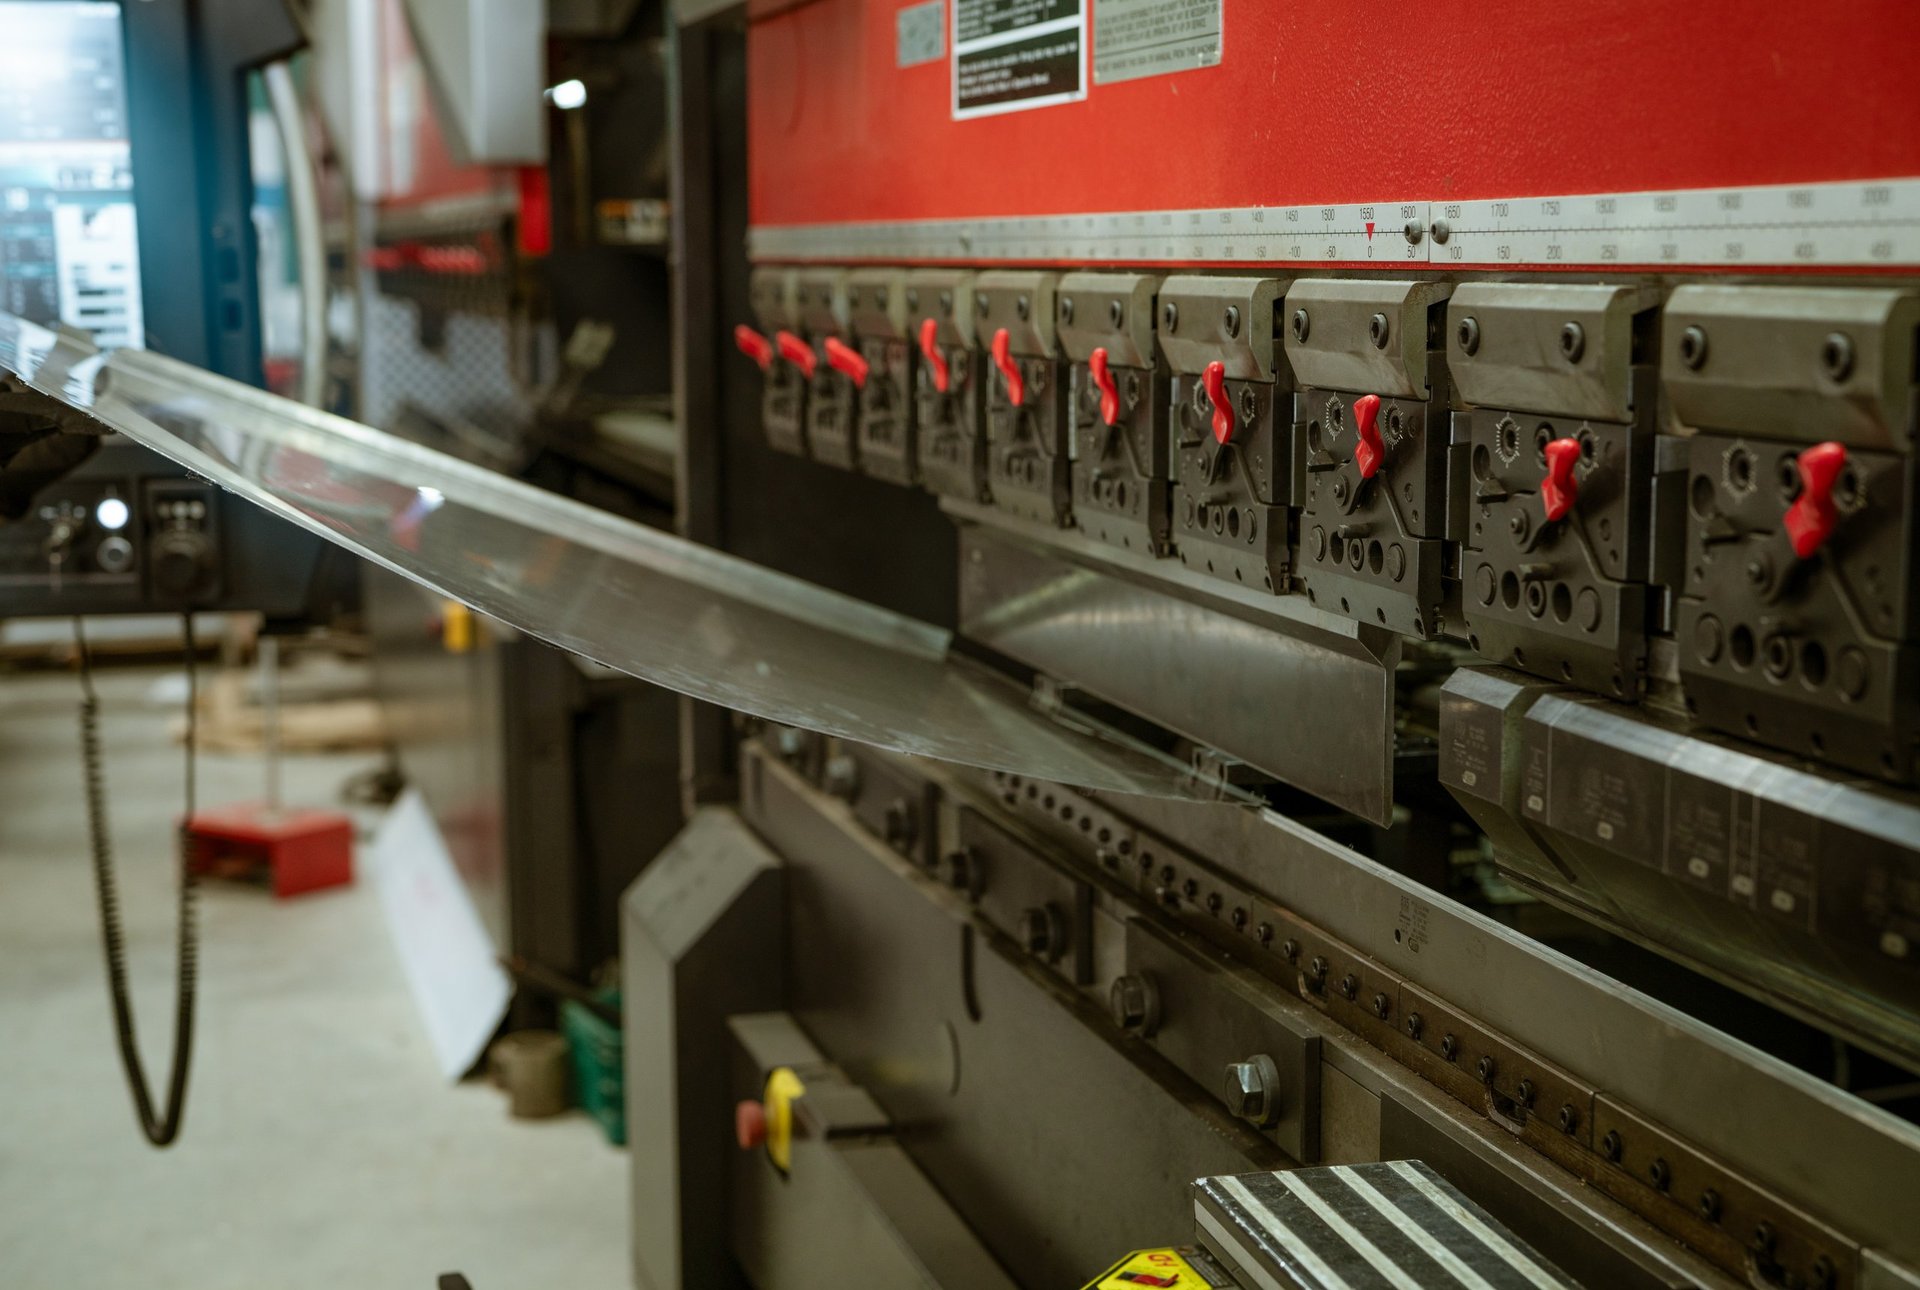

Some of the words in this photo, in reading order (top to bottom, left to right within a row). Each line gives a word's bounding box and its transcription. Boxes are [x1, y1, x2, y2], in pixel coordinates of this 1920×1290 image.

[1285, 210, 1298, 222] 1450
[1321, 208, 1335, 221] 1500
[1360, 207, 1374, 220] 1550
[1401, 206, 1416, 219] 1600
[1445, 205, 1461, 219] 1650
[1491, 203, 1509, 217] 1700
[1541, 201, 1560, 216] 1750
[1288, 246, 1301, 258] -100
[1326, 246, 1336, 258] -50
[1367, 246, 1373, 258] 0
[1407, 245, 1416, 258] 50
[1450, 246, 1463, 259] 100
[1497, 246, 1510, 259] 150
[1547, 245, 1562, 259] 200
